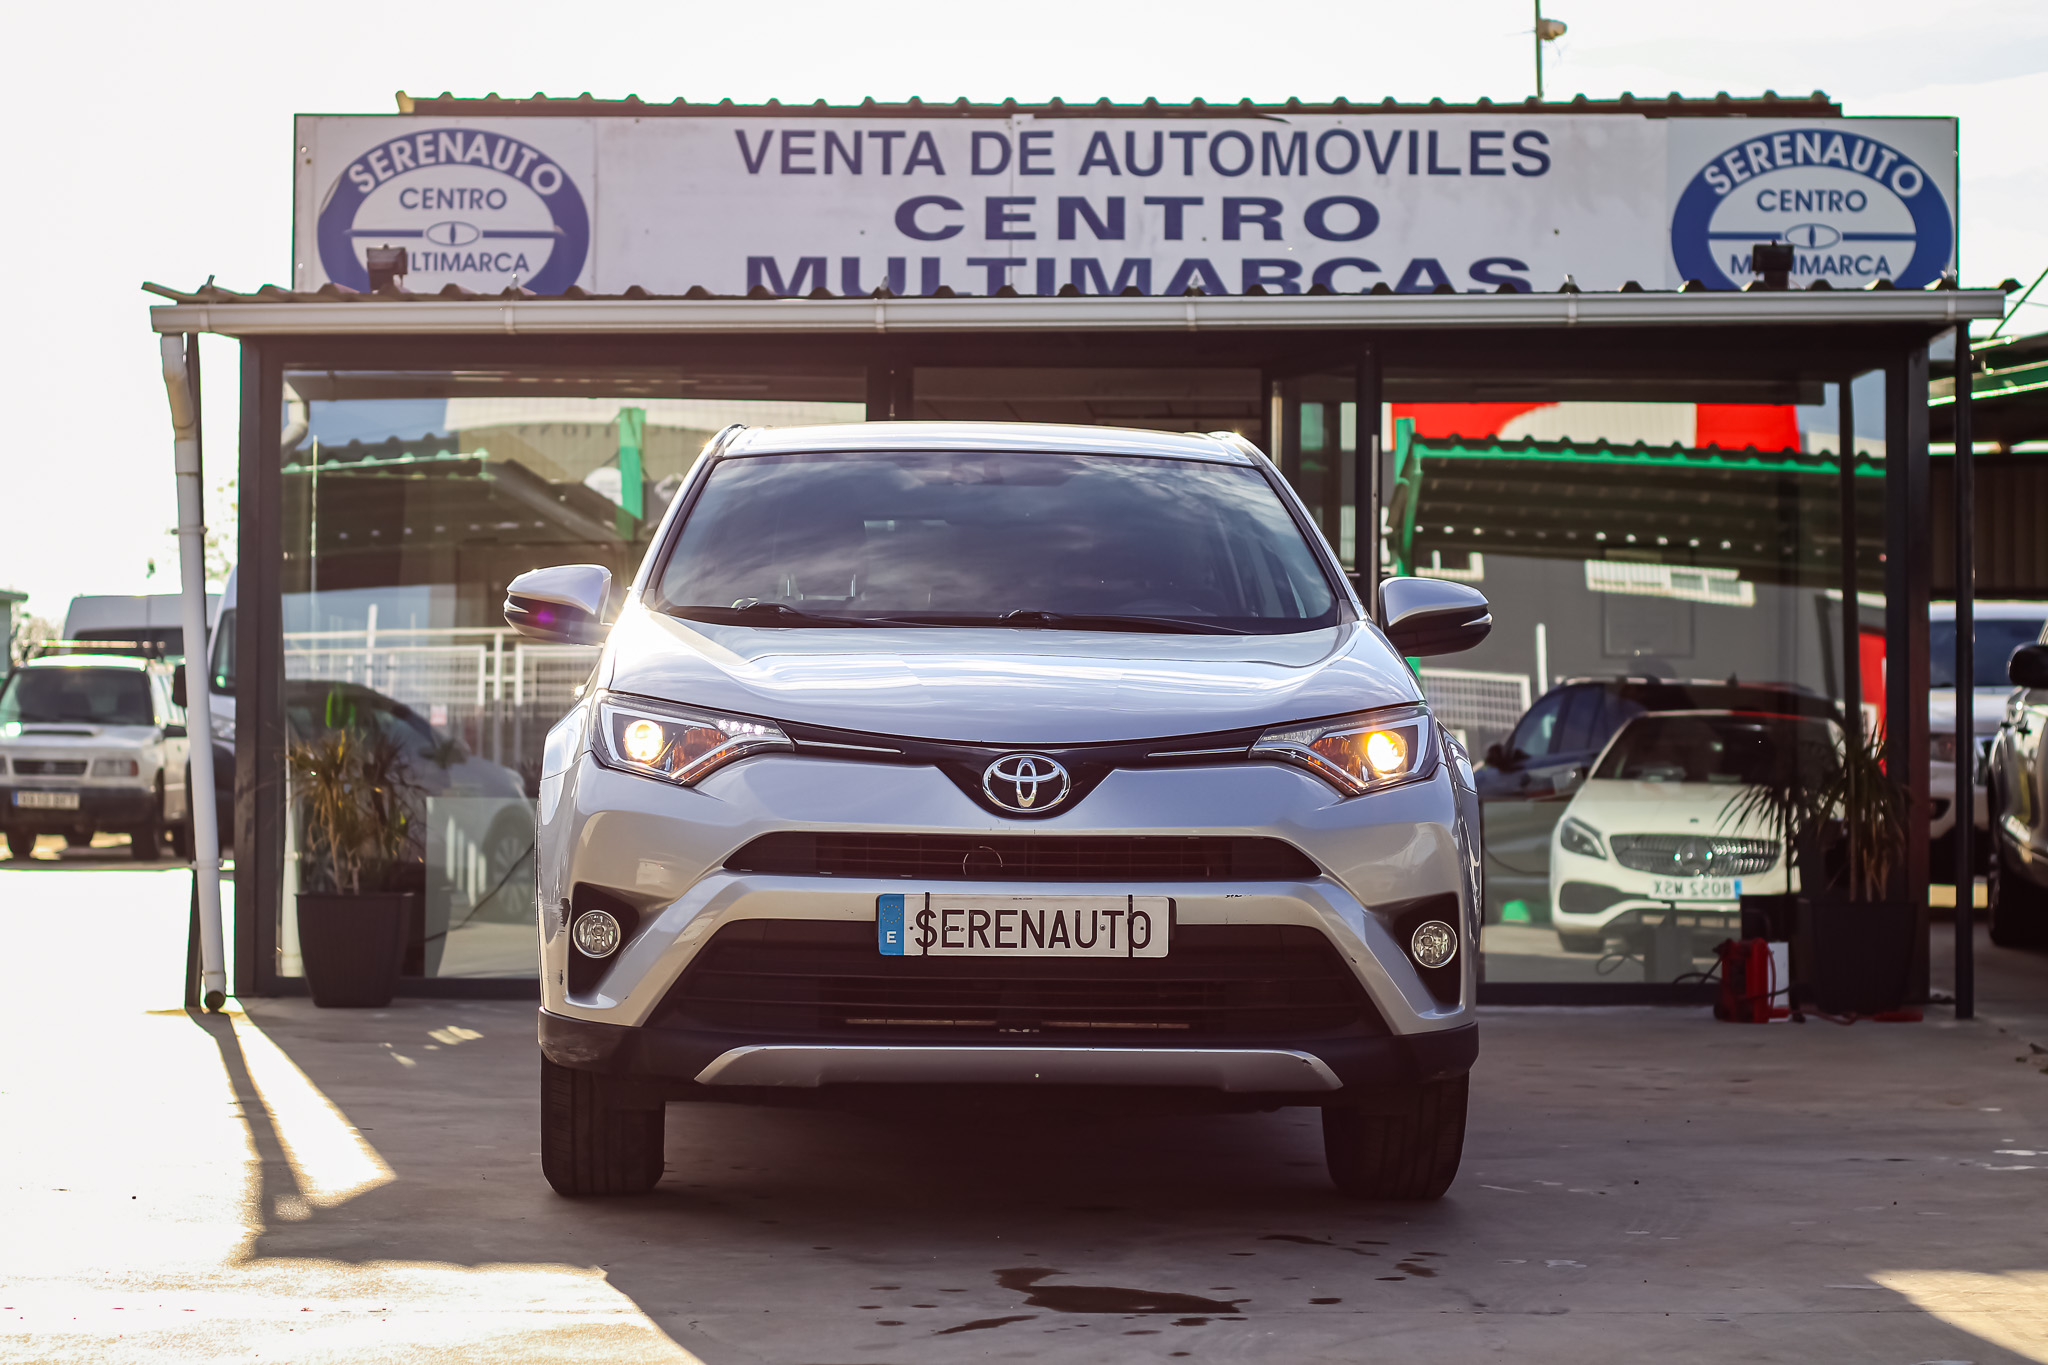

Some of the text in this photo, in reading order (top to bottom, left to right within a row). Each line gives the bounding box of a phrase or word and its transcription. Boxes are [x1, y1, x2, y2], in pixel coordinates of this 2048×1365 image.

[348, 131, 563, 196] SERENAUTO
[735, 128, 1552, 178] VENTA DE AUTOMOVILES
[1704, 132, 1924, 198] SERENAUTO
[400, 187, 507, 210] CENTRO
[894, 195, 1381, 242] CENTRO
[1756, 189, 1868, 212] CENTRO
[746, 256, 1533, 296] MULTIMARCAS
[1730, 254, 1891, 276] MIMARCA
[886, 931, 897, 943] E
[914, 909, 1152, 949] SERENAUTO
